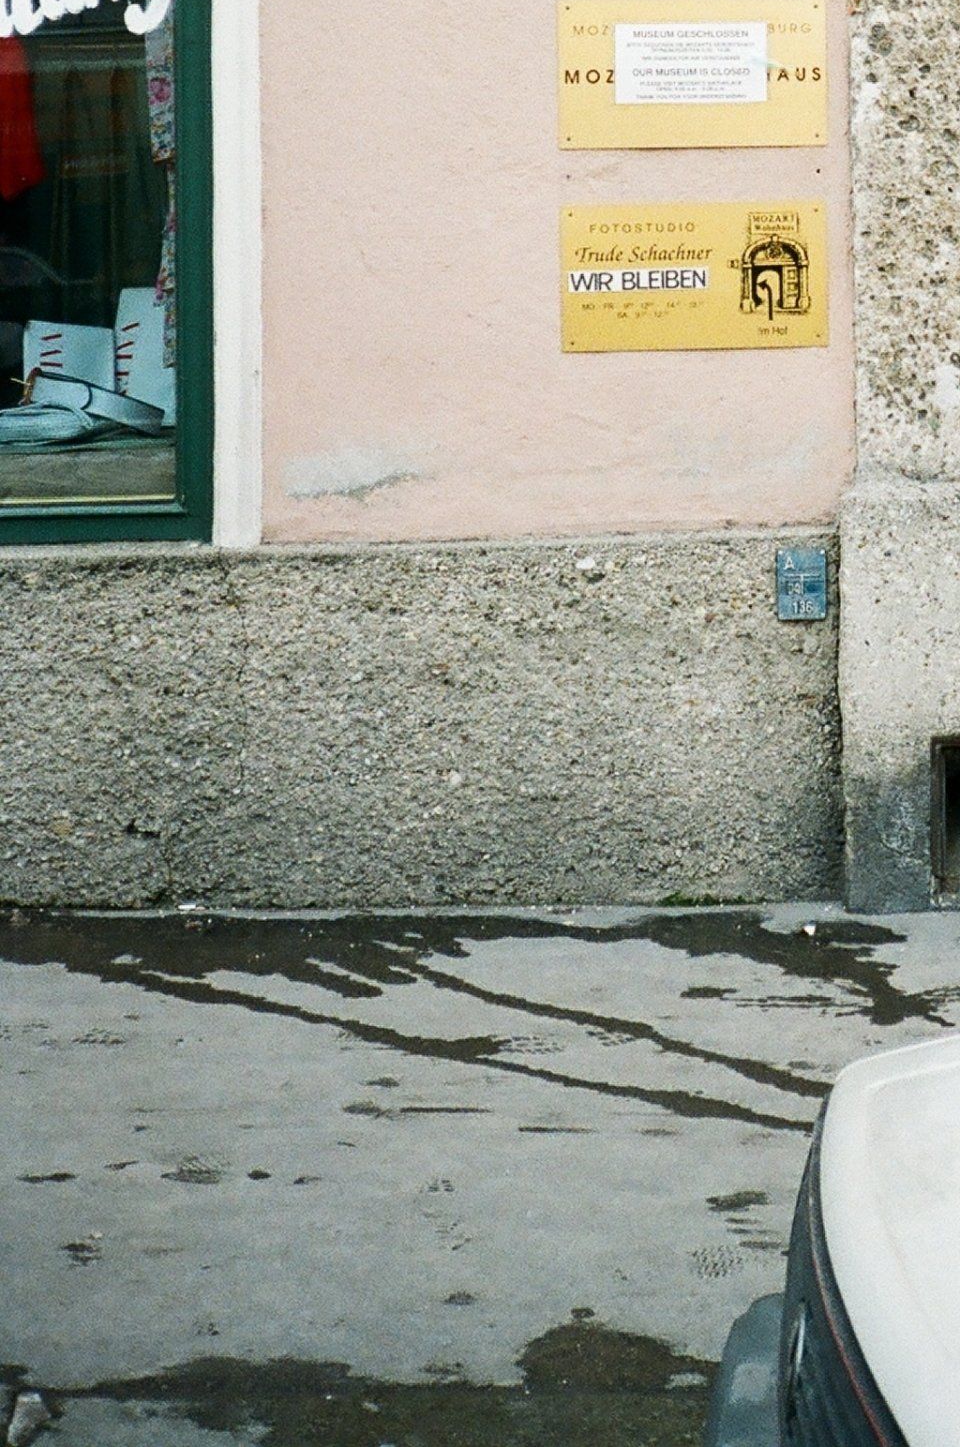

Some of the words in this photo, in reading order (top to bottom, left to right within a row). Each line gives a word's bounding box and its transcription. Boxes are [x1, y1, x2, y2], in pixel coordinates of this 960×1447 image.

[573, 24, 609, 36] MOZ
[767, 22, 812, 34] BURG
[633, 30, 674, 39] MUSEUM
[676, 29, 749, 38] GESCHLOSSEN
[564, 68, 614, 84] MOZ
[767, 66, 822, 82] AUS
[632, 68, 653, 77] OUR
[655, 67, 697, 76] MUSEUM
[699, 67, 708, 76] IS
[711, 67, 750, 76] CLOSED
[752, 214, 794, 223] MOZART
[589, 221, 695, 234] FOTOSTUDIO
[575, 245, 623, 263] Trude
[627, 242, 713, 263] Schachner
[570, 272, 613, 291] WIR
[622, 269, 706, 291] BLEIBEN
[783, 556, 795, 570] A
[792, 600, 815, 613] 136
